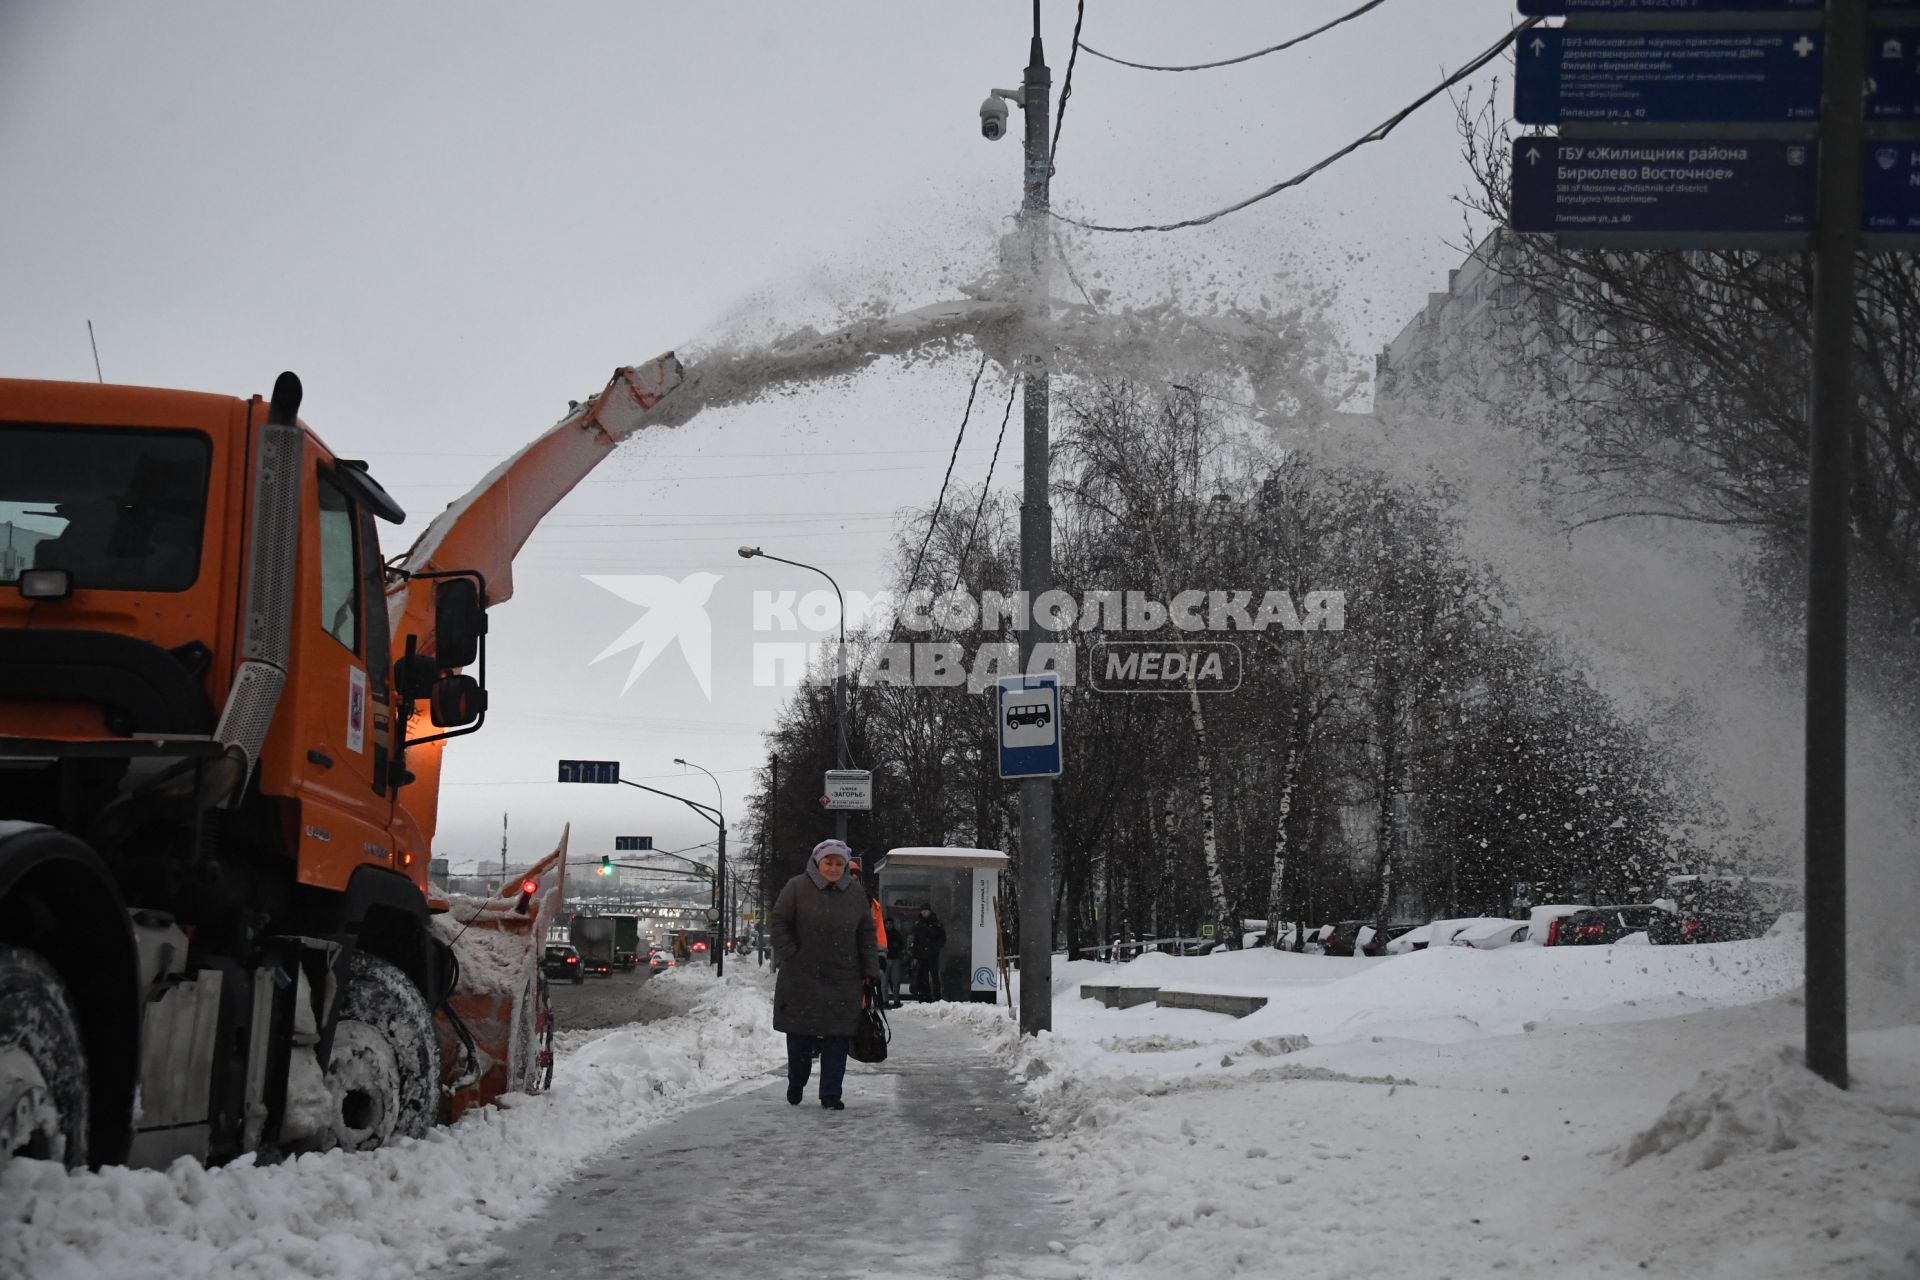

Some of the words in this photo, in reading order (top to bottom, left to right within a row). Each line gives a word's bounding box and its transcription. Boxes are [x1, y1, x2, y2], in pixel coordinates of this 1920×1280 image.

[1585, 37, 1645, 47] «Московский
[1561, 61, 1595, 70] Филиал
[1560, 108, 1606, 118] Липецкая
[1557, 147, 1584, 160] ГБУ
[1587, 147, 1685, 162] «Жилищник
[1688, 147, 1748, 163] района
[1557, 166, 1638, 182] Бирюлево
[1641, 166, 1734, 180] Восточное»
[1582, 183, 1616, 192] Moscow
[1555, 213, 1597, 223] Липецкая
